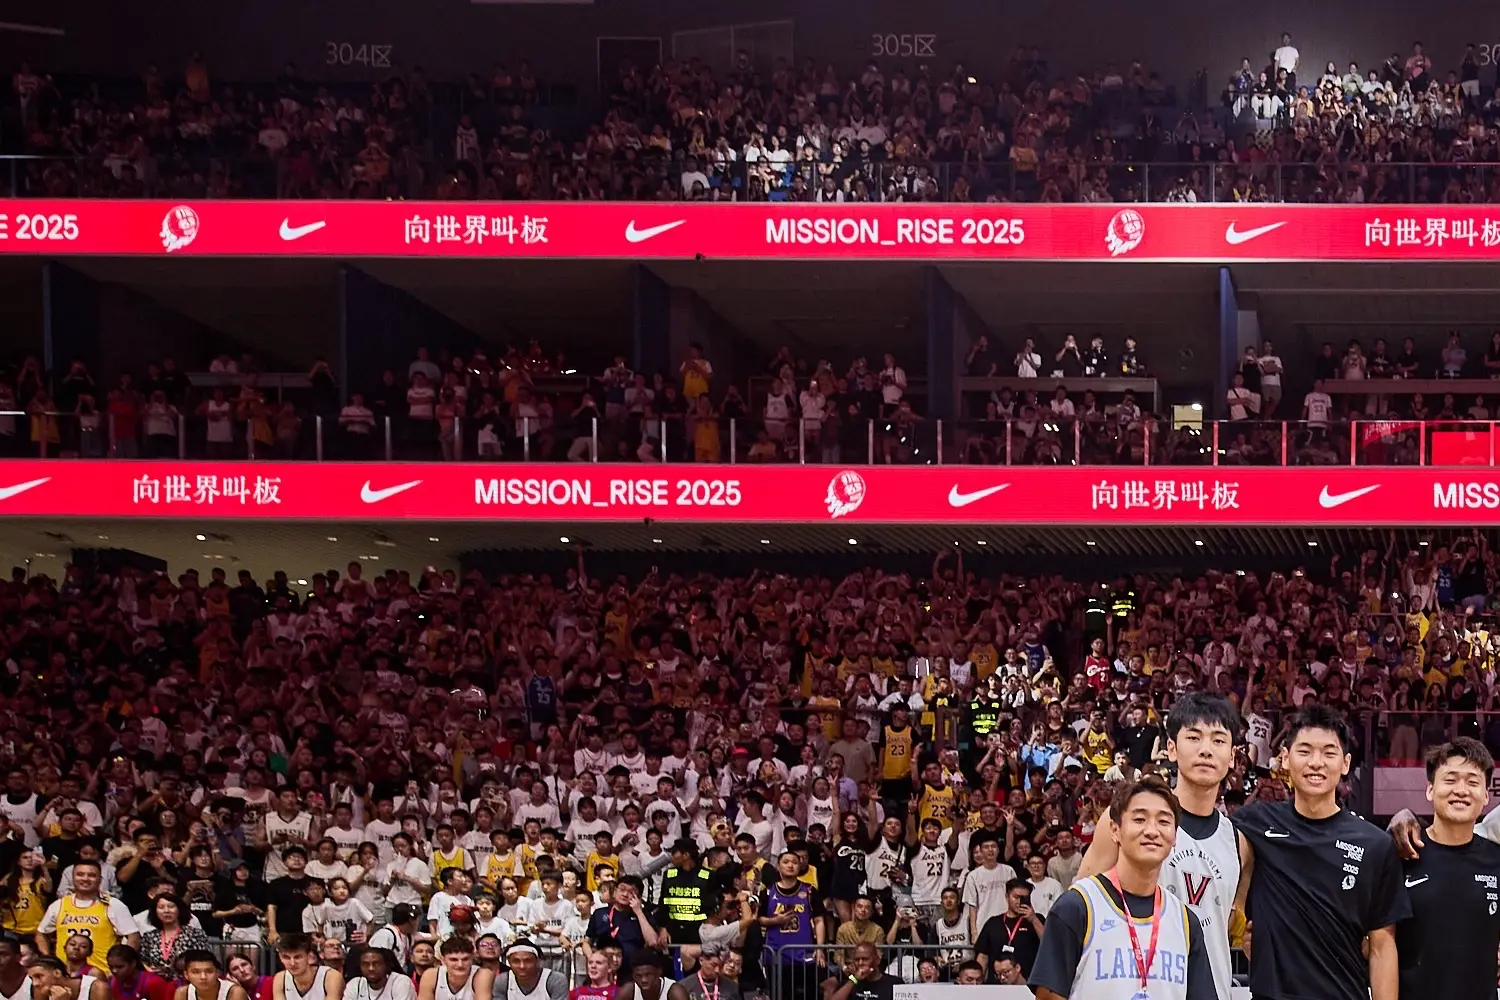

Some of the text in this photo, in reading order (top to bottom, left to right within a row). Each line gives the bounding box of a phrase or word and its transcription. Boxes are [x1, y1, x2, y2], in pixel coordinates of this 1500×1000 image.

[871, 35, 936, 58] 305区
[325, 41, 394, 69] 304区
[15, 214, 78, 239] 2025
[405, 215, 548, 243] 向世界叫板
[766, 218, 1025, 244] MISSION_RISE 2025
[133, 474, 281, 505] 向世界叫板
[475, 479, 742, 506] MISSION_RISE 2025
[1091, 480, 1239, 509] 向世界叫板
[1254, 726, 1267, 739] 23
[891, 744, 905, 757] 23
[931, 804, 947, 819] 23
[1335, 839, 1364, 856] MISSION
[849, 856, 863, 872] 23
[1168, 849, 1194, 868] VERITAS
[926, 862, 944, 877] 23
[1342, 862, 1359, 876] 2025
[1474, 874, 1498, 884] MISSION
[1181, 869, 1214, 908] V
[14, 897, 30, 911] 23
[773, 902, 805, 915] LARS
[60, 912, 100, 926] LAKERS
[940, 933, 966, 945] LAKERS
